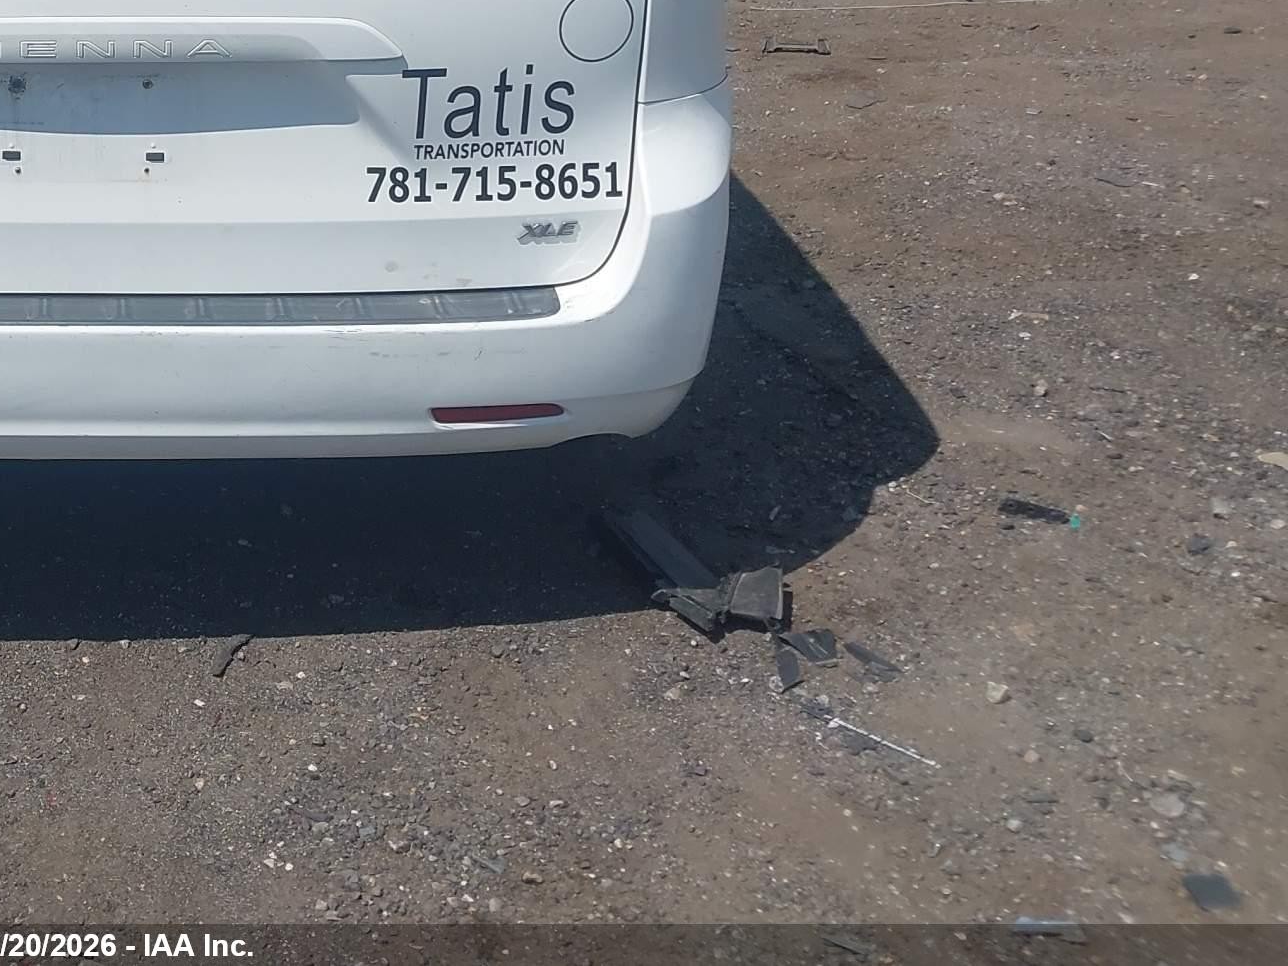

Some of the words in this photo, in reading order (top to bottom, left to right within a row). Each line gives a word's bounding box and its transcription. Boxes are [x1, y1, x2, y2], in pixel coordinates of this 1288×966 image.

[401, 64, 575, 139] Tatis
[413, 138, 565, 160] TRANSPORTATION
[366, 161, 623, 203] 781-715-8651
[516, 220, 579, 243] XLE
